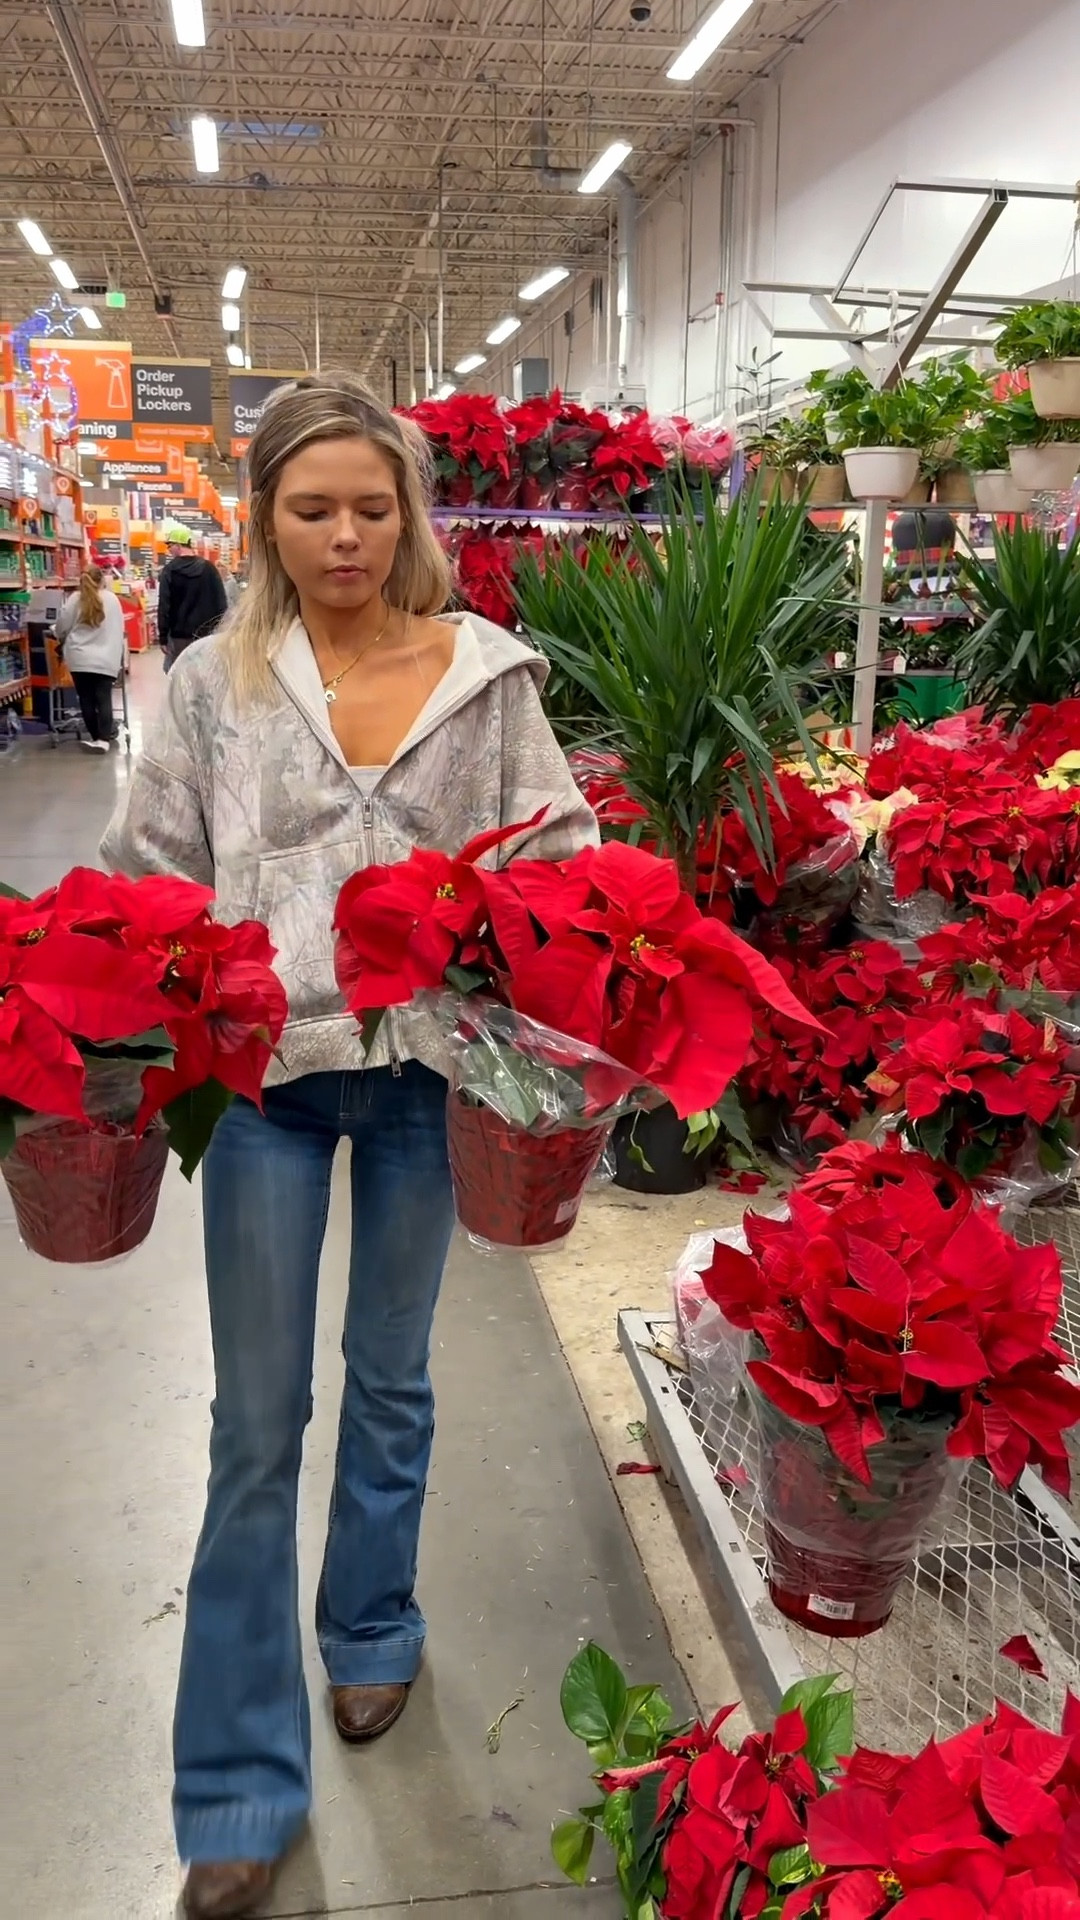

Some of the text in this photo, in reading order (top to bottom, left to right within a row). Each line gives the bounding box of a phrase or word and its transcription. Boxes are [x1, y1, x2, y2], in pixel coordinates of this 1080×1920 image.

[136, 369, 175, 382] Order
[137, 384, 183, 399] Pickup
[138, 399, 192, 411] Lockers
[103, 462, 161, 474] Appliances
